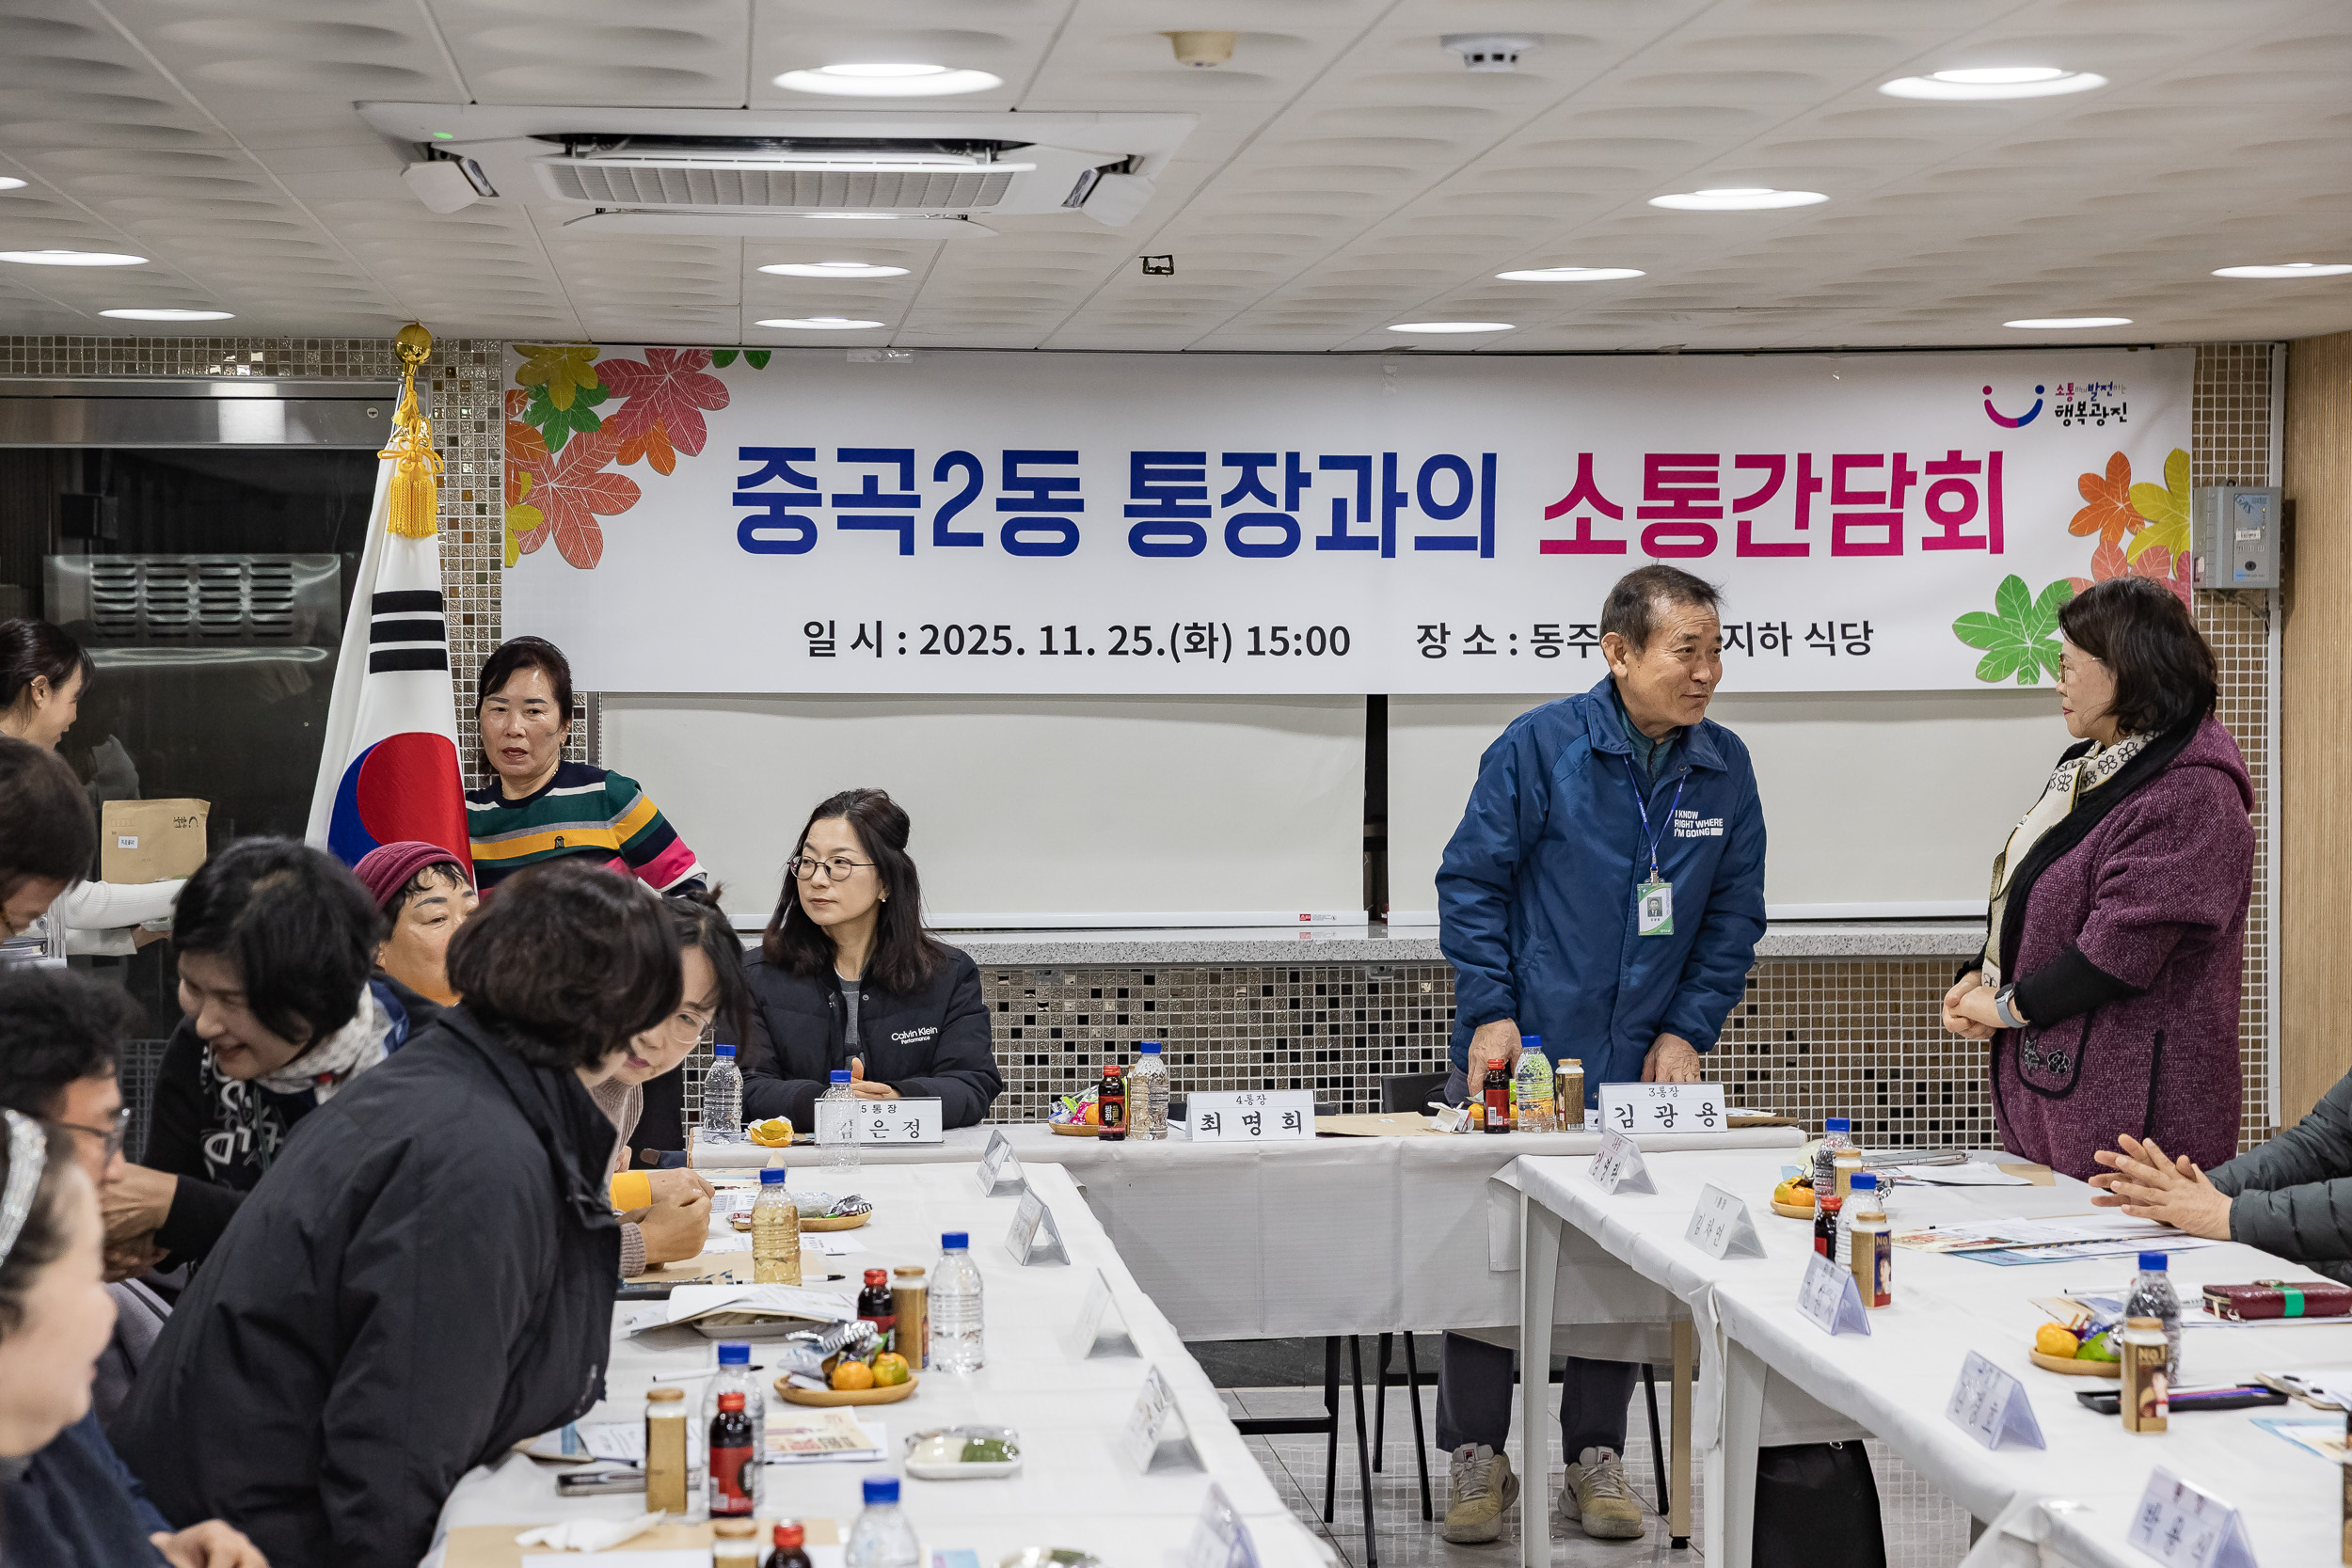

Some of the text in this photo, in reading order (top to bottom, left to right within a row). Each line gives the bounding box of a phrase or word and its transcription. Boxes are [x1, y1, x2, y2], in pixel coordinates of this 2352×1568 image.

[2054, 401, 2128, 427] 행복광진
[732, 447, 2005, 560] 중곡2동 통장과의 소통간담회
[919, 625, 1026, 657] 2025.
[1041, 626, 1096, 657] 11.
[1108, 622, 1233, 664] 25.(화)
[1247, 626, 1352, 657] 15:00
[1722, 621, 1793, 657] 지하
[1804, 619, 1875, 657] 식당
[1674, 817, 1724, 829] RIGHT WHERE
[1678, 810, 1699, 819] KNOW
[1674, 827, 1710, 838] I'M GOING
[891, 1025, 939, 1042] Calvin Klein
[900, 1035, 931, 1046] Performance
